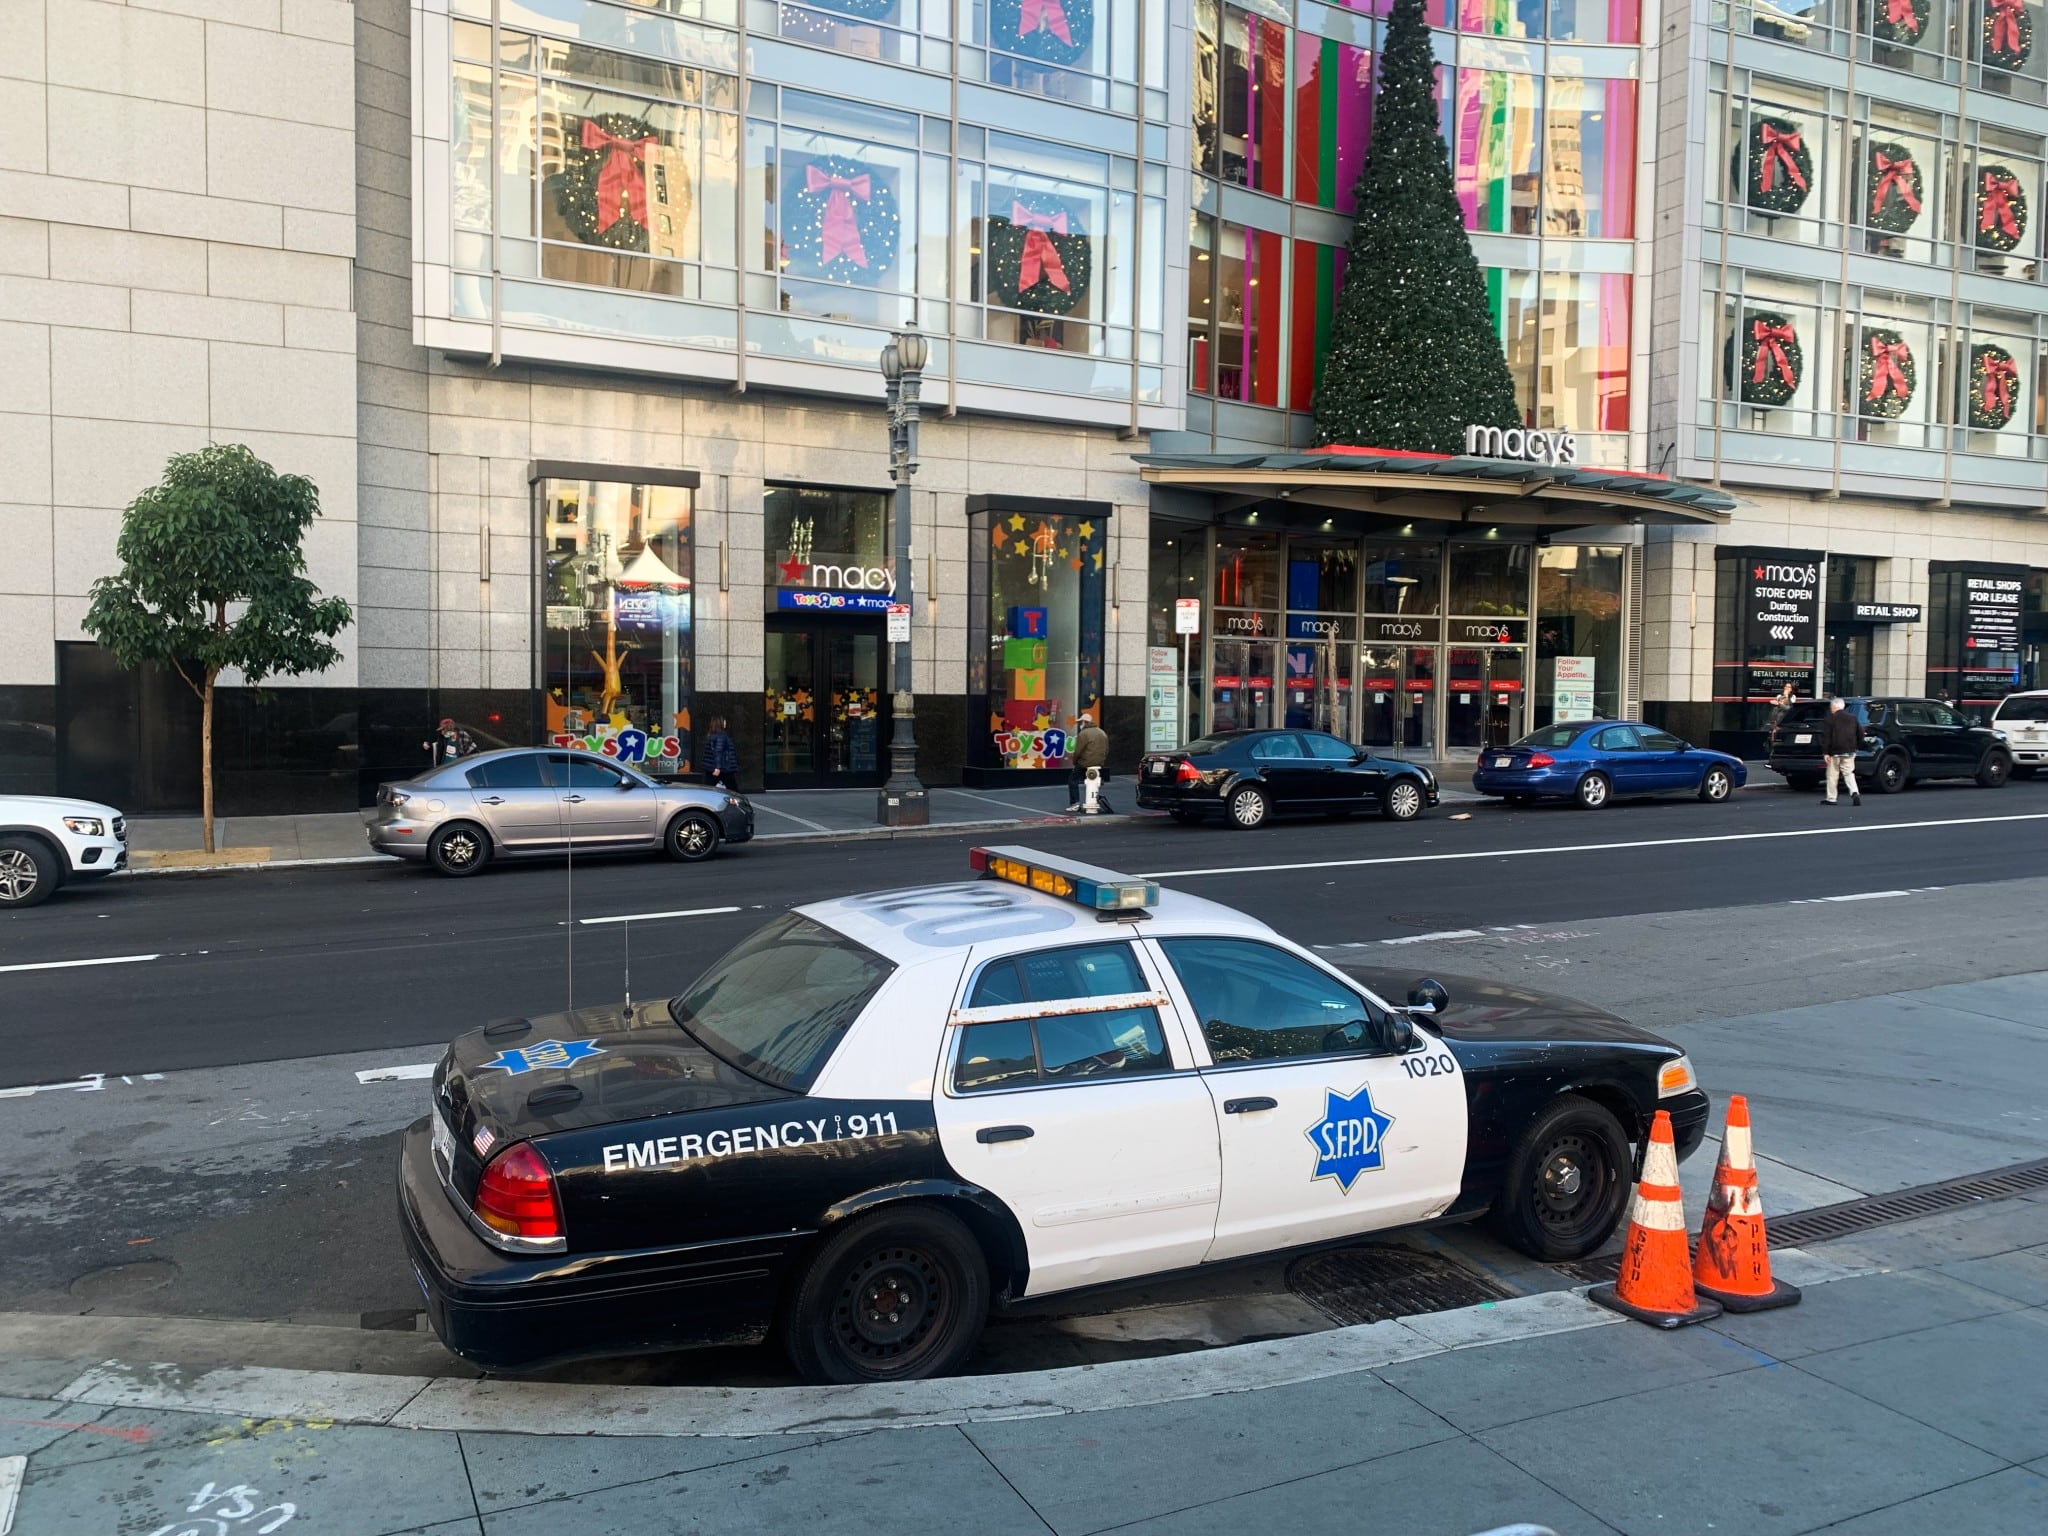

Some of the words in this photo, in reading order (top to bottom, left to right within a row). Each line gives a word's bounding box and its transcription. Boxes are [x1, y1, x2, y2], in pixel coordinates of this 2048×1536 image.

[1466, 424, 1577, 467] macy's
[1766, 564, 1816, 588] macy's
[1967, 579, 1996, 590] RETAIL
[1996, 580, 2022, 591] SHOPS
[1755, 587, 1786, 599] STORE
[1787, 589, 1812, 600] OPEN
[1970, 592, 1990, 602] FOR
[1990, 593, 2019, 603] LEASE
[1770, 601, 1798, 613] During
[1857, 605, 1890, 616] RETAIL
[1892, 607, 1919, 617] SHOP
[1757, 612, 1809, 623] Construction
[1381, 622, 1422, 638] macy's
[1753, 670, 1775, 678] RETAIL
[1400, 1054, 1455, 1079] 1020
[603, 1118, 827, 1173] EMERGENCY
[834, 1114, 842, 1141] DIAL
[847, 1111, 898, 1139] 911
